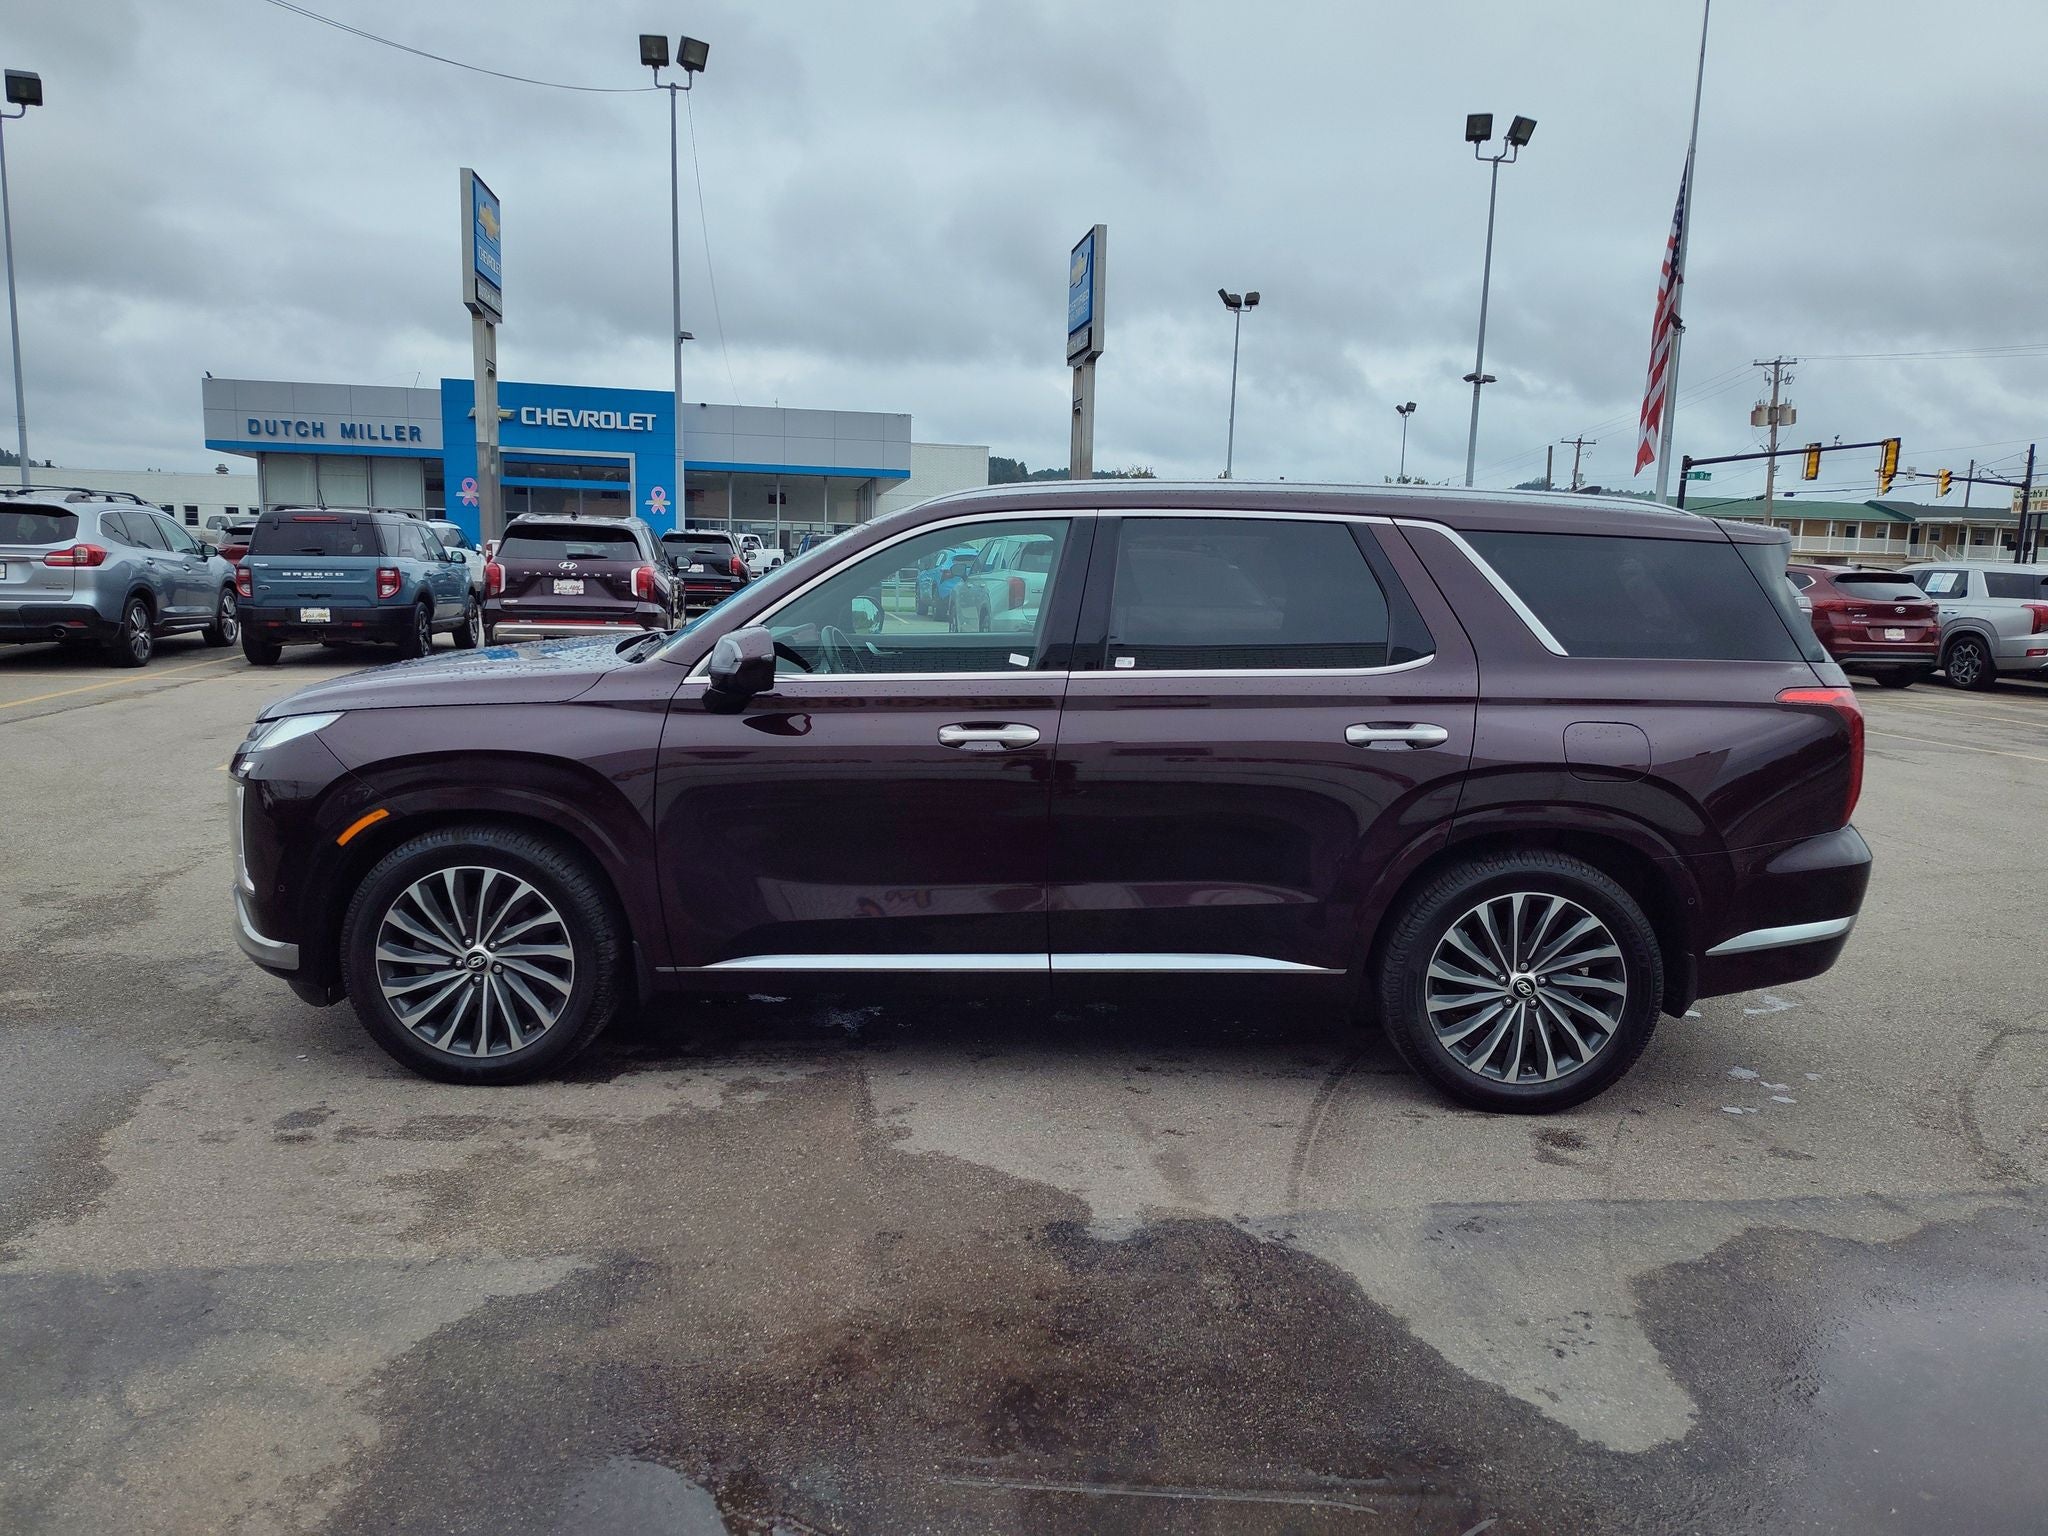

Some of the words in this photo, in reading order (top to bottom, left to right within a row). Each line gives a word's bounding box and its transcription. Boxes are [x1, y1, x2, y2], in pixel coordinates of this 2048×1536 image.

[247, 418, 325, 438] DUTCH
[341, 423, 422, 442] MILLER
[521, 406, 657, 431] CHEVROLET
